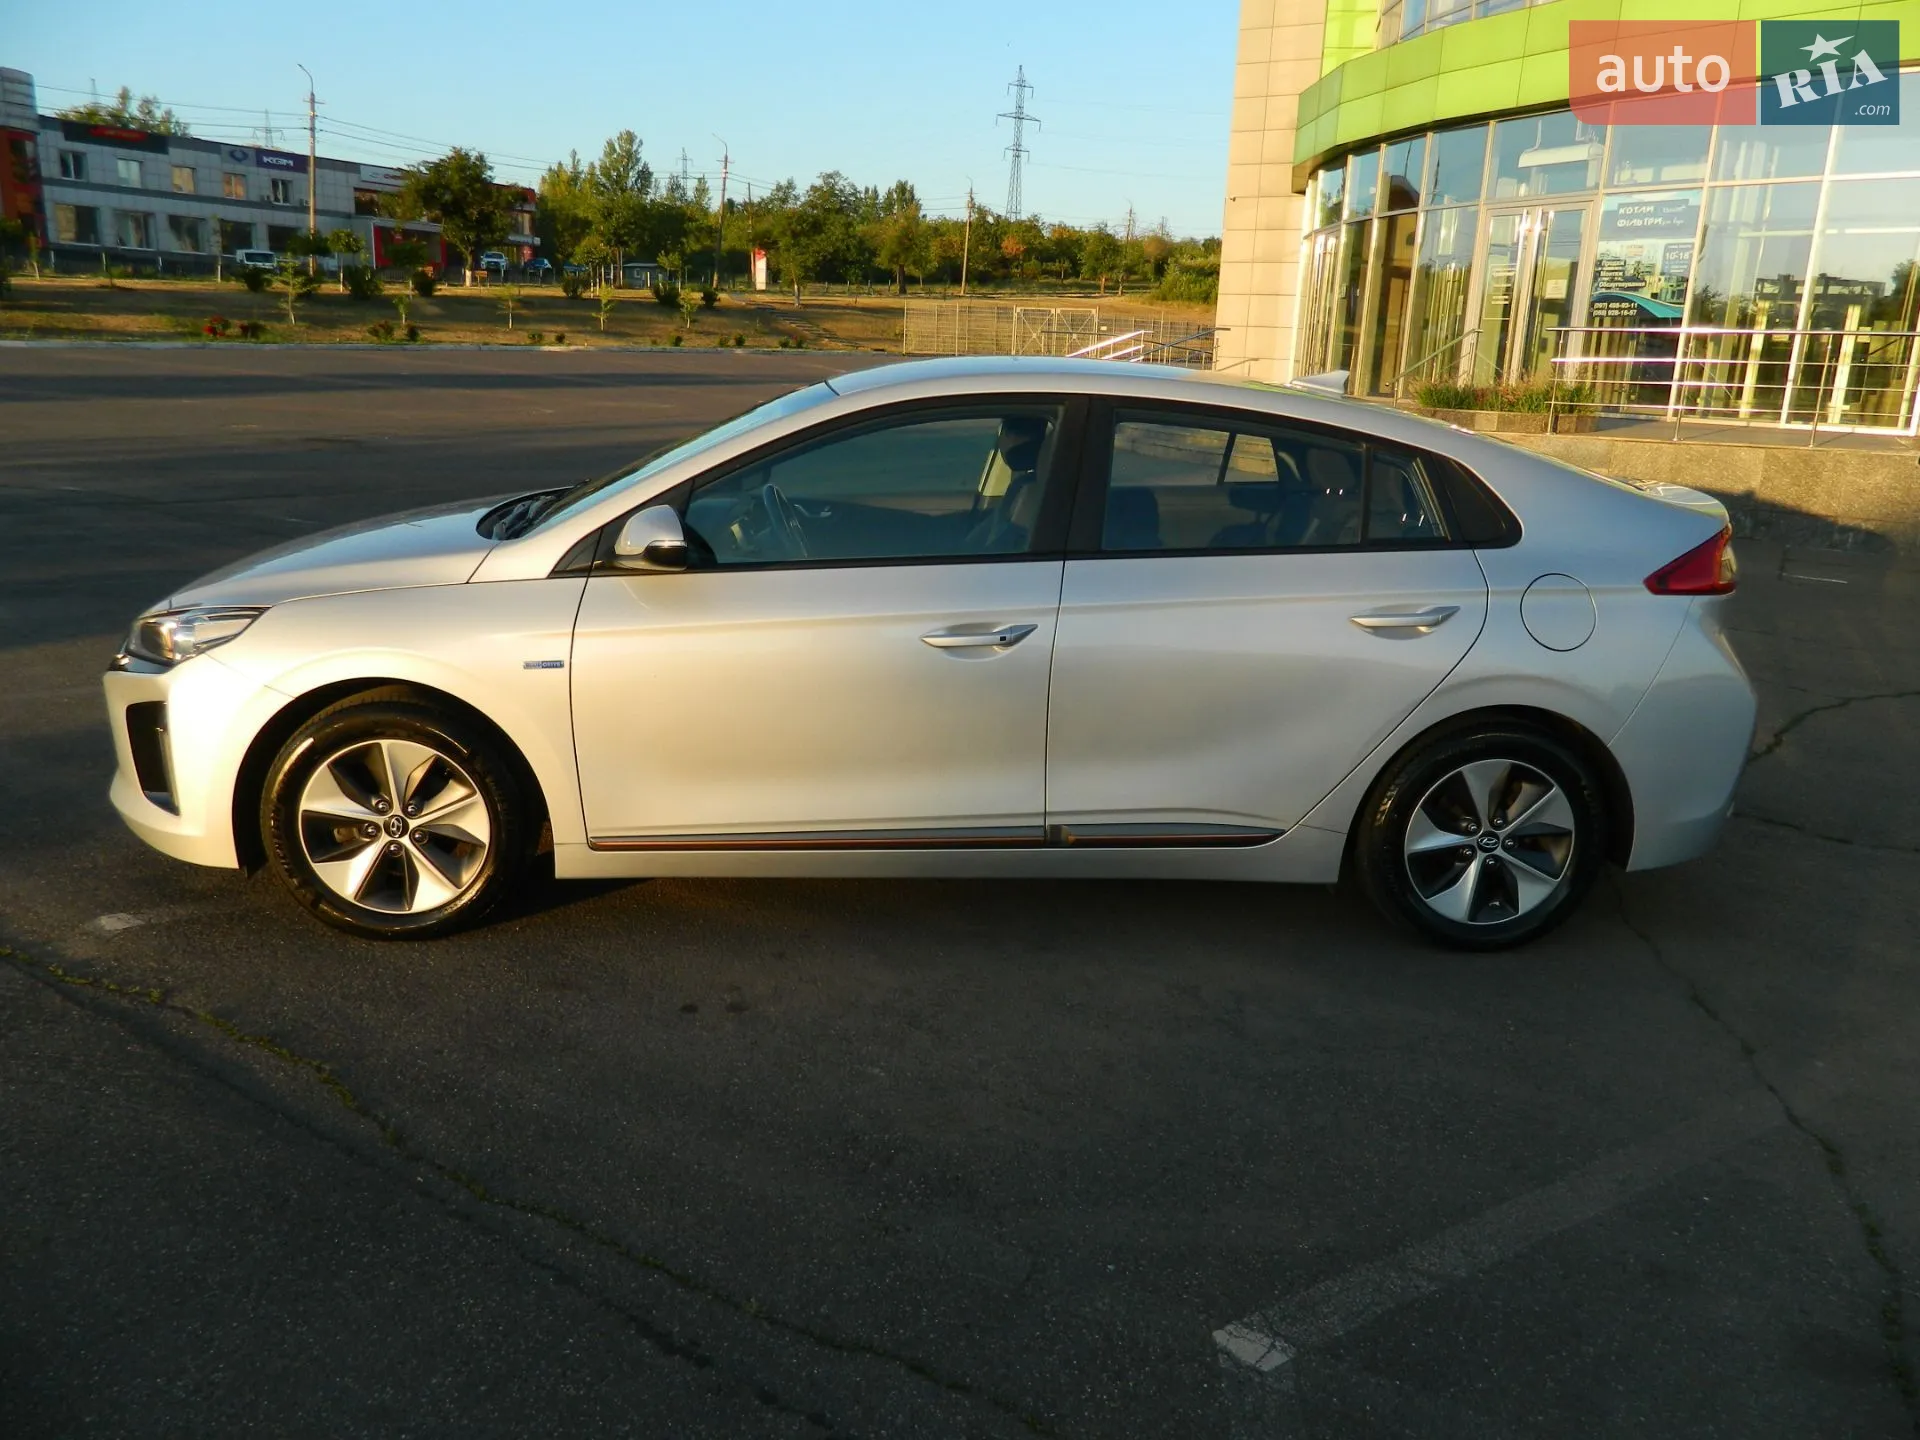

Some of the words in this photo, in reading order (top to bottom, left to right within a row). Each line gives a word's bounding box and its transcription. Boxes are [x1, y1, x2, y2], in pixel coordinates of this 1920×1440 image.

[262, 155, 294, 167] KGM
[1619, 205, 1654, 214] КОТЛИ
[1617, 217, 1663, 227] ФІЛЬТРИ
